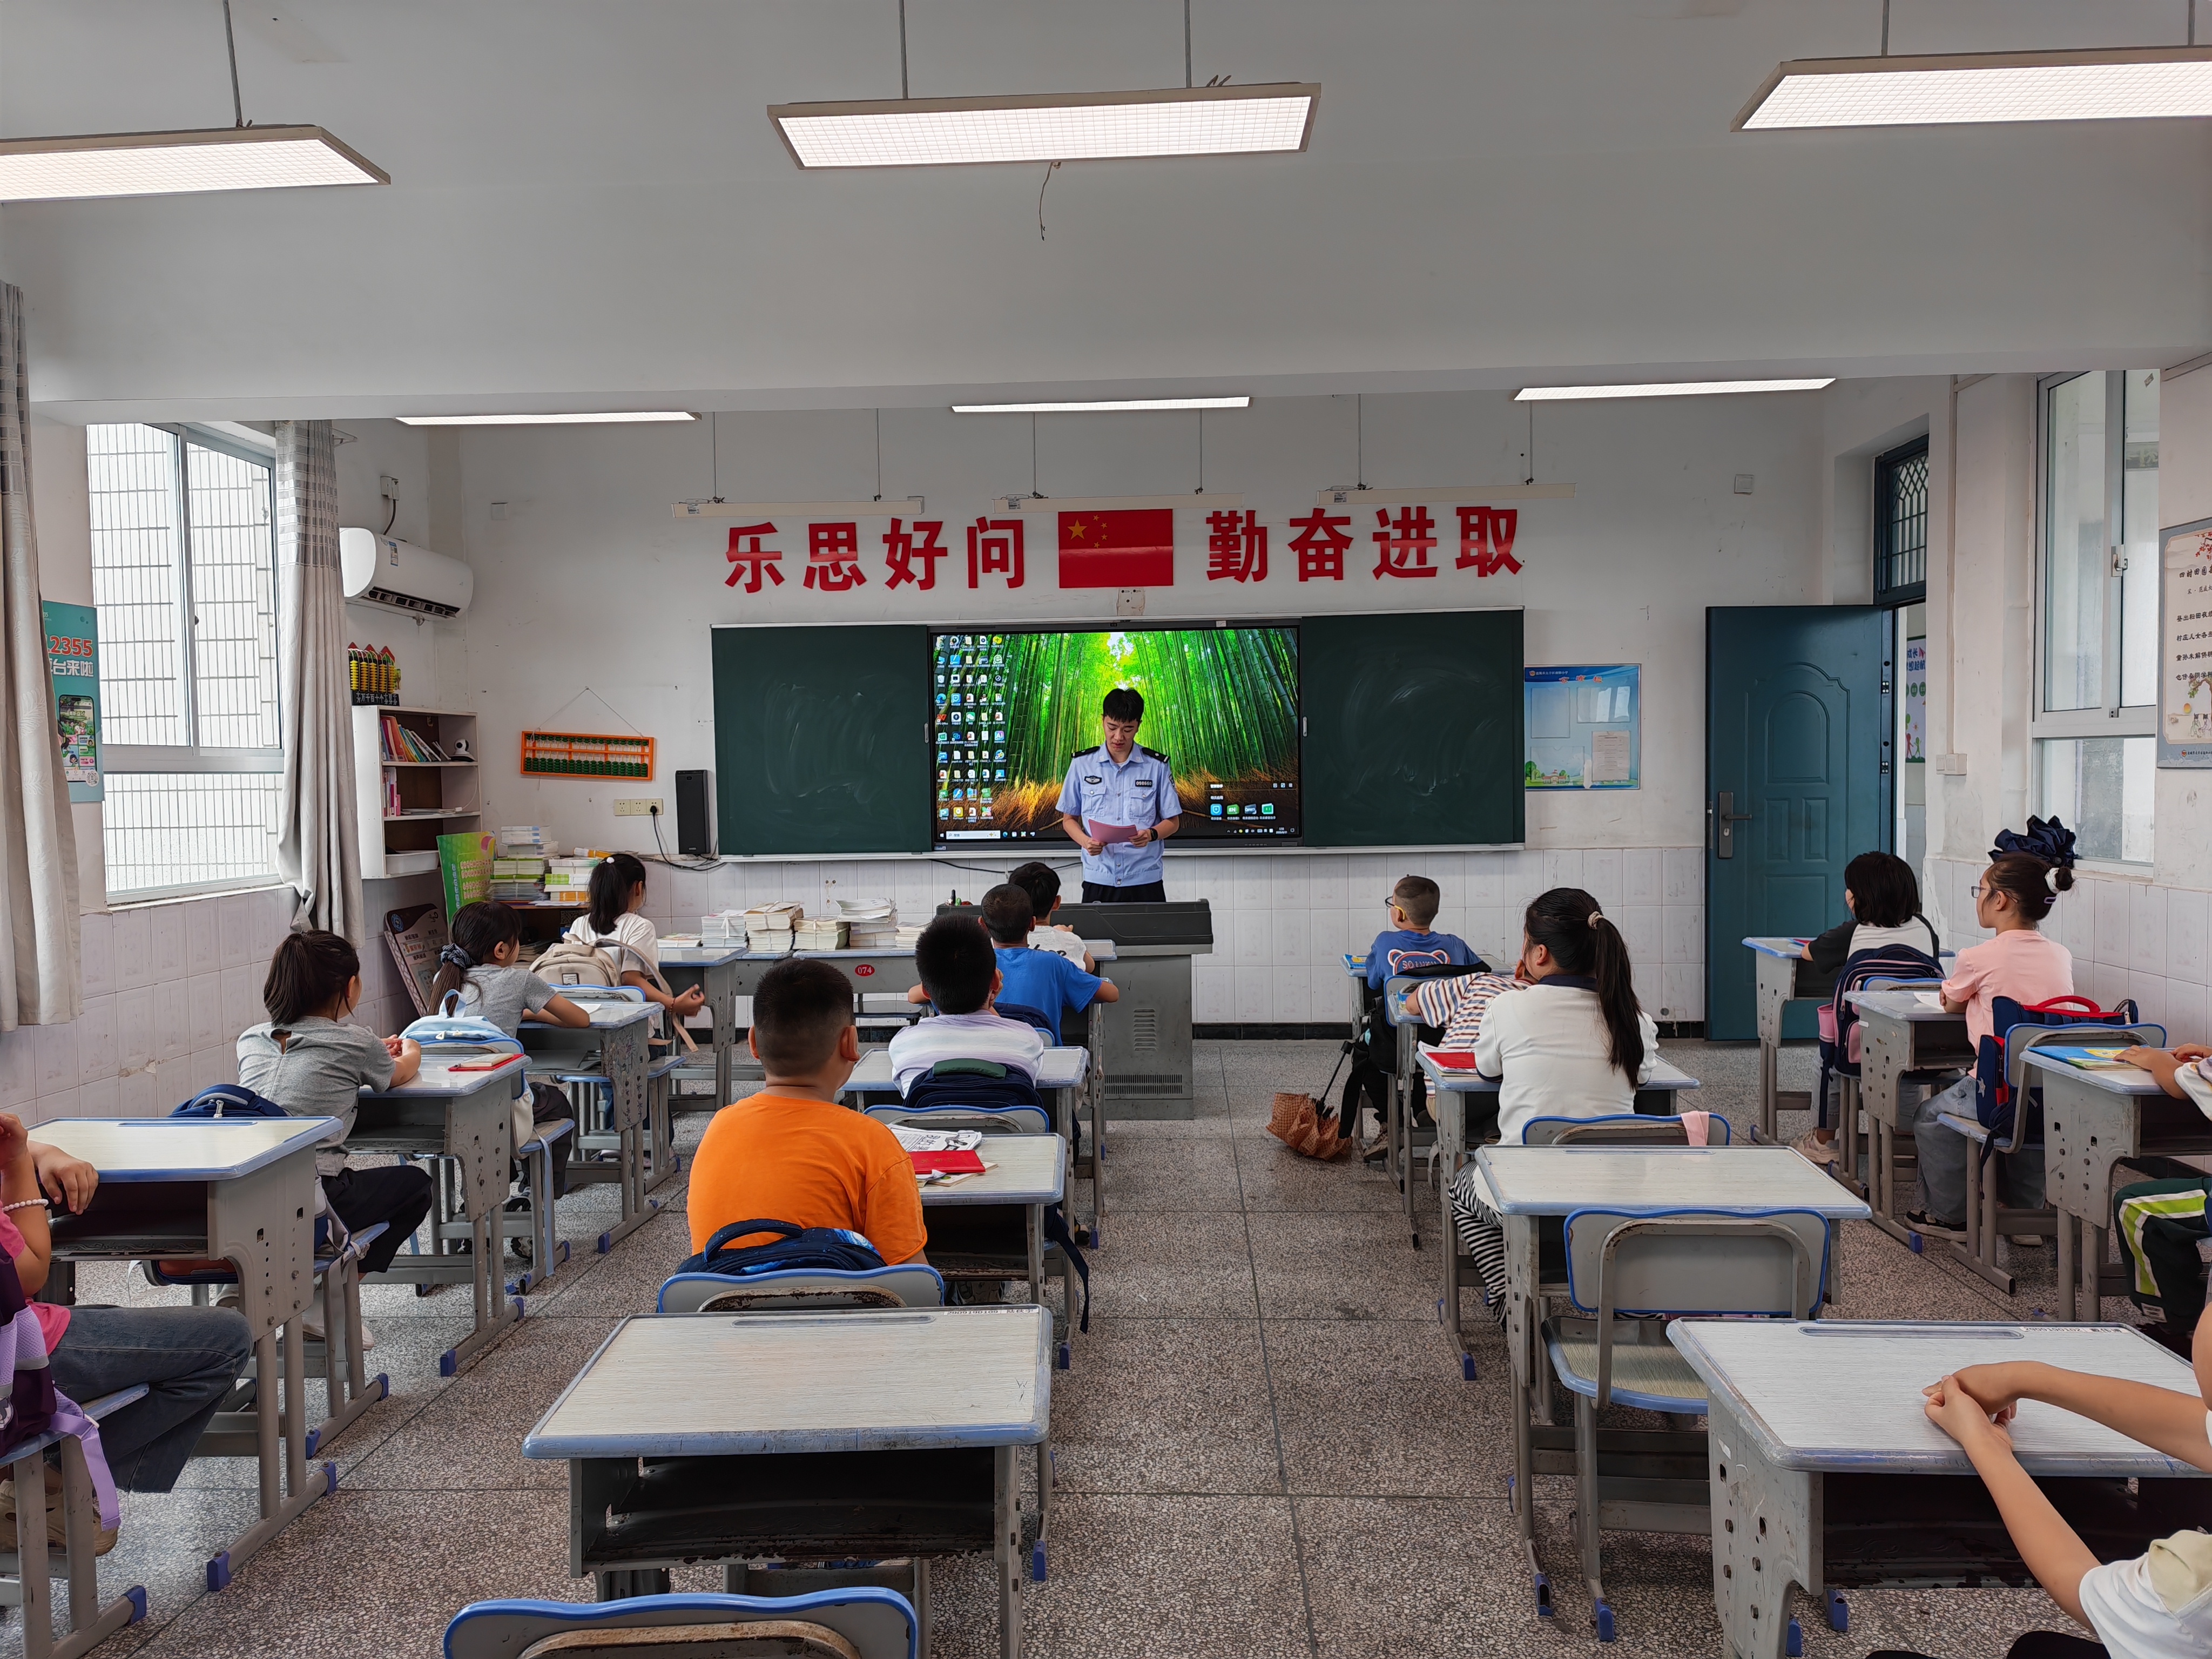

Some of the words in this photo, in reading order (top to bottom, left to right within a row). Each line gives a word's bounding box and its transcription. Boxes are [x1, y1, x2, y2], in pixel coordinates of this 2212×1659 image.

[725, 517, 1024, 593] 乐思好问
[1206, 507, 1522, 583] 勤奋进取
[46, 635, 93, 657] 2355
[858, 966, 872, 974] 074
